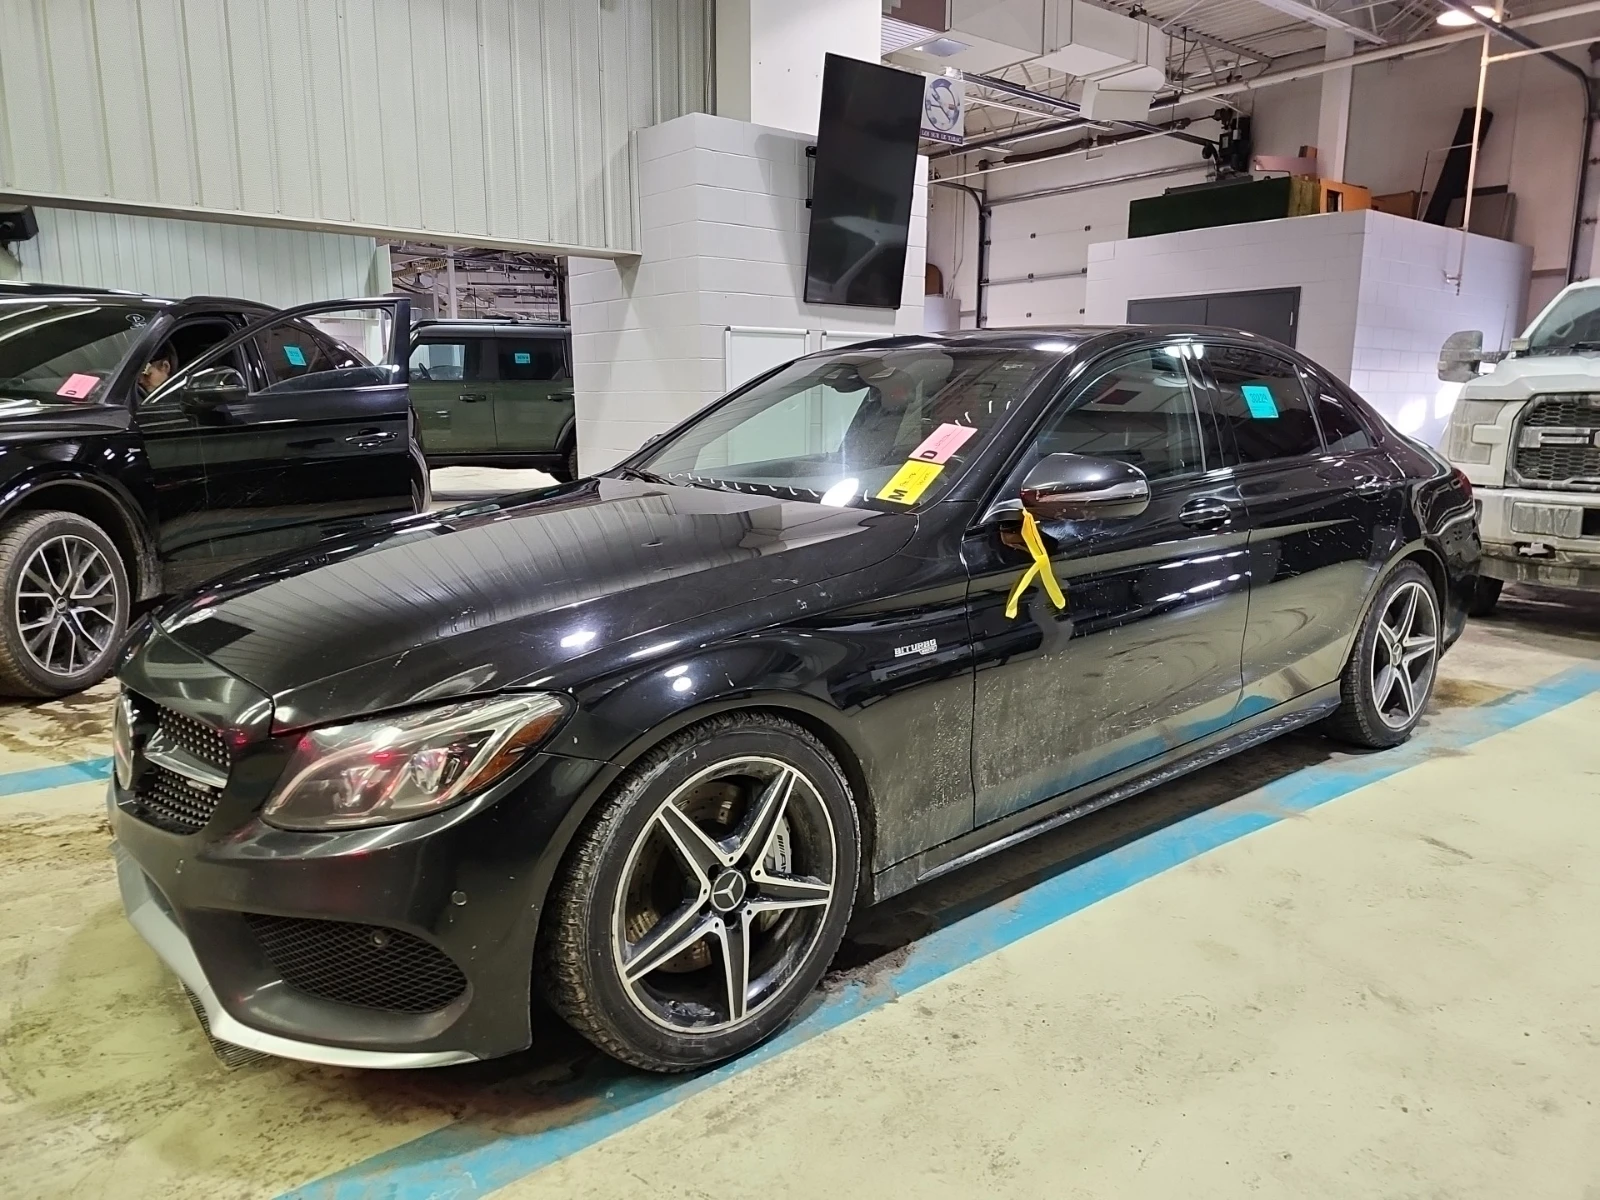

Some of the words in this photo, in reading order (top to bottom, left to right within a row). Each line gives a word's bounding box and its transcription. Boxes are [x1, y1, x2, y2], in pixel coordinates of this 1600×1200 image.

[919, 450, 938, 460] D
[887, 488, 908, 501] M
[894, 638, 937, 656] BITURBO
